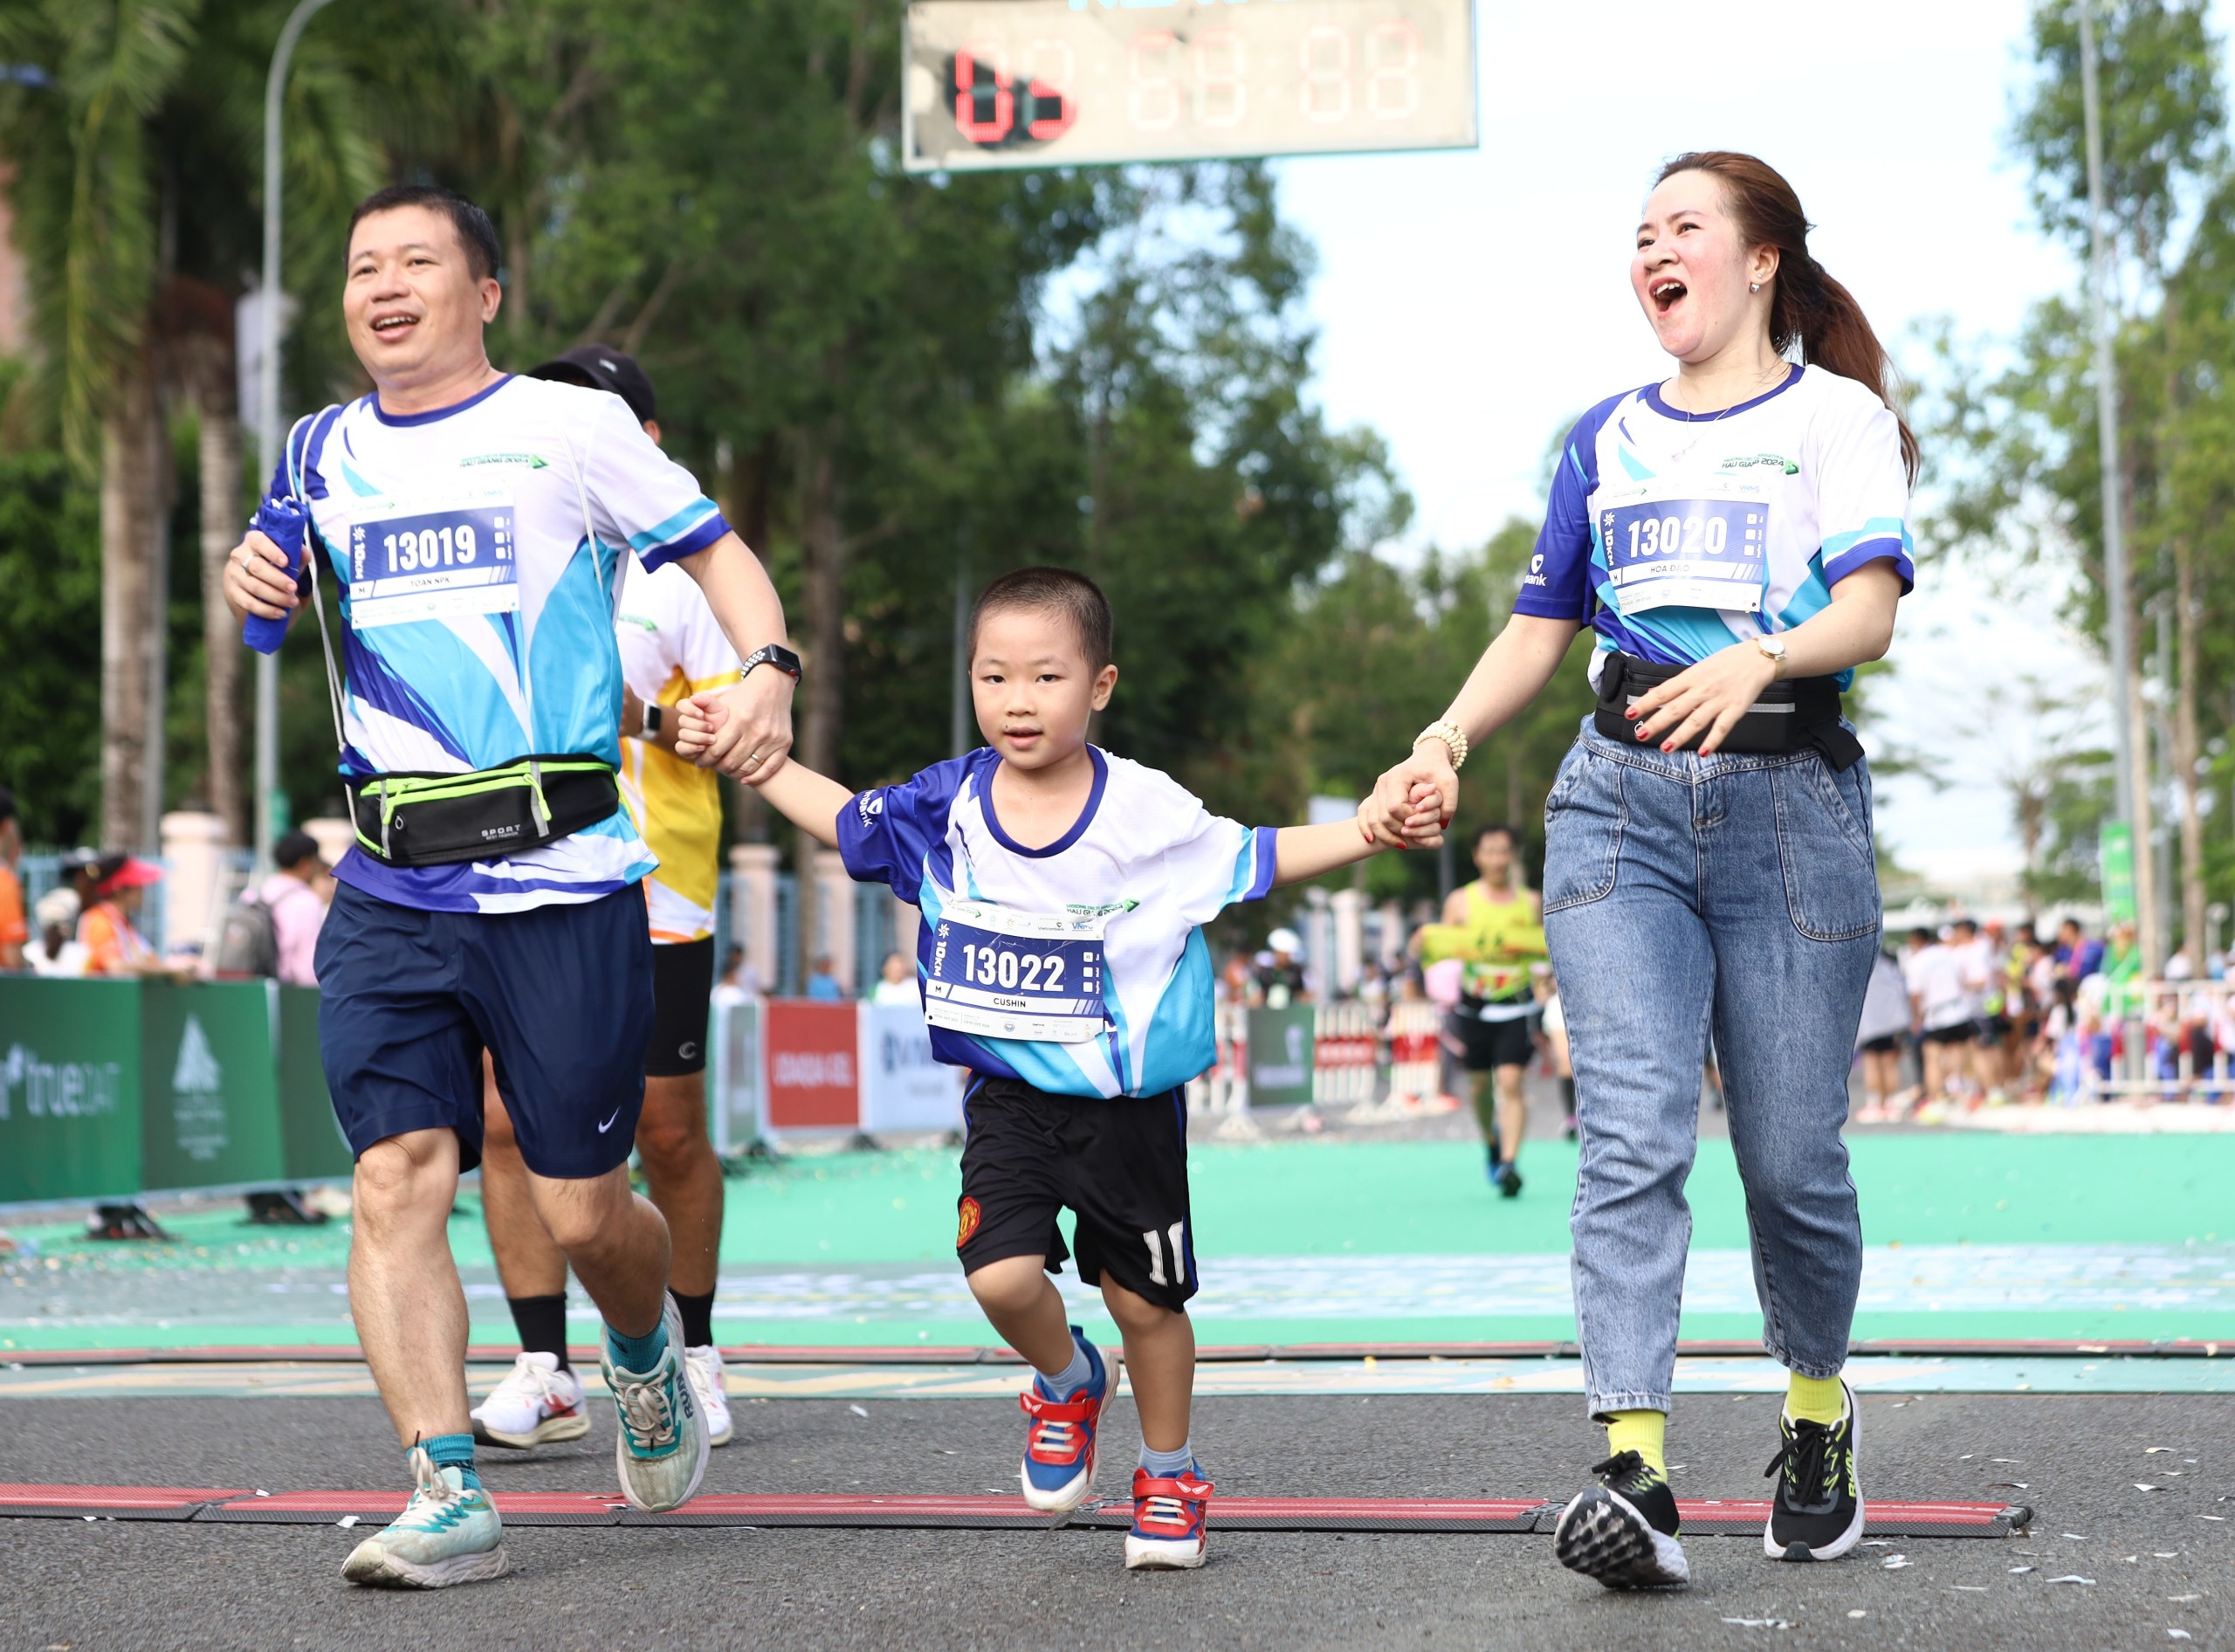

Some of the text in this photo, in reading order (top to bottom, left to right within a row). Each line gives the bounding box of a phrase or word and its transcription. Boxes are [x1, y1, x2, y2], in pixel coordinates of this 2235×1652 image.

[1761, 458, 1785, 467] 2024
[383, 525, 477, 573] 13019
[1605, 528, 1615, 567] 10KM
[1627, 515, 1728, 559] 13020
[354, 542, 366, 580] 10KM
[1650, 565, 1668, 574] HOA
[481, 824, 520, 836] SPORT
[933, 941, 947, 977] 10KM
[963, 944, 1065, 992] 13022
[935, 985, 942, 994] M
[994, 997, 1027, 1008] CUSHIN
[676, 1372, 694, 1419] RUN
